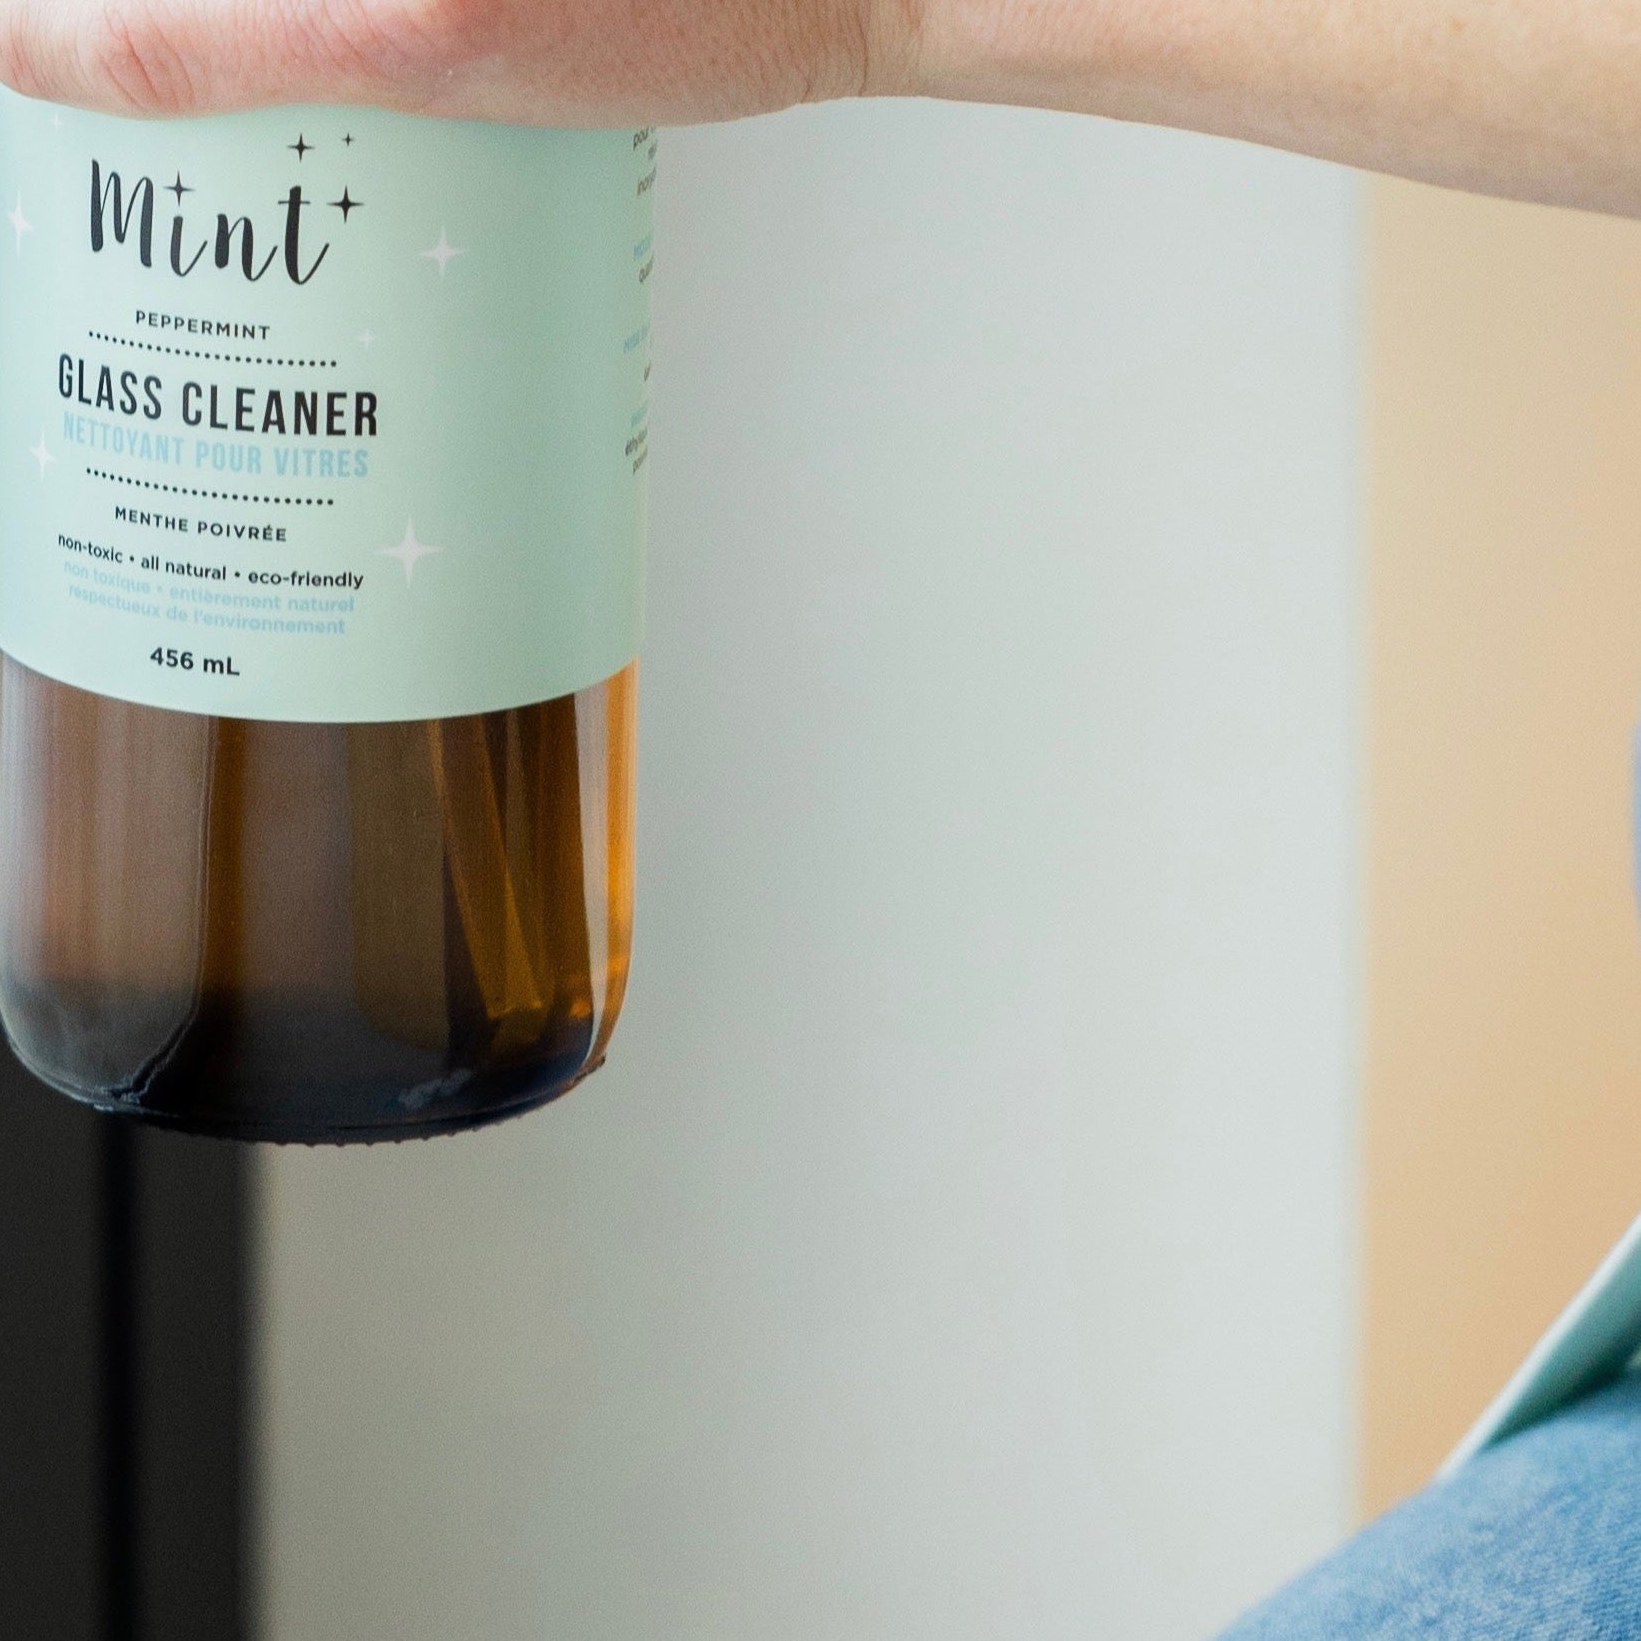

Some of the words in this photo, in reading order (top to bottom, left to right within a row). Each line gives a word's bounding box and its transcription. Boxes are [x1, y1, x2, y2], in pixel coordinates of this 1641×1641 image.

[90, 157, 330, 285] Mint
[135, 309, 270, 341] PEPPERMINT
[58, 352, 162, 420] GLASS
[182, 381, 377, 437] CLEANER
[63, 410, 185, 465] NETTOYANT
[195, 441, 262, 475] POUR
[273, 447, 370, 478] VITRES
[115, 505, 188, 532] MENTHE
[197, 521, 287, 542] POIVRÉE
[58, 533, 123, 564] non-toxic
[141, 555, 159, 571] all
[165, 559, 226, 581] natural
[248, 569, 364, 590] eco-friendly
[63, 561, 89, 579] non
[92, 567, 151, 596] toxique
[287, 595, 356, 613] naturel
[69, 584, 160, 618] respectueux
[166, 606, 188, 623] de
[150, 646, 195, 671] 456
[202, 656, 240, 676] mL
